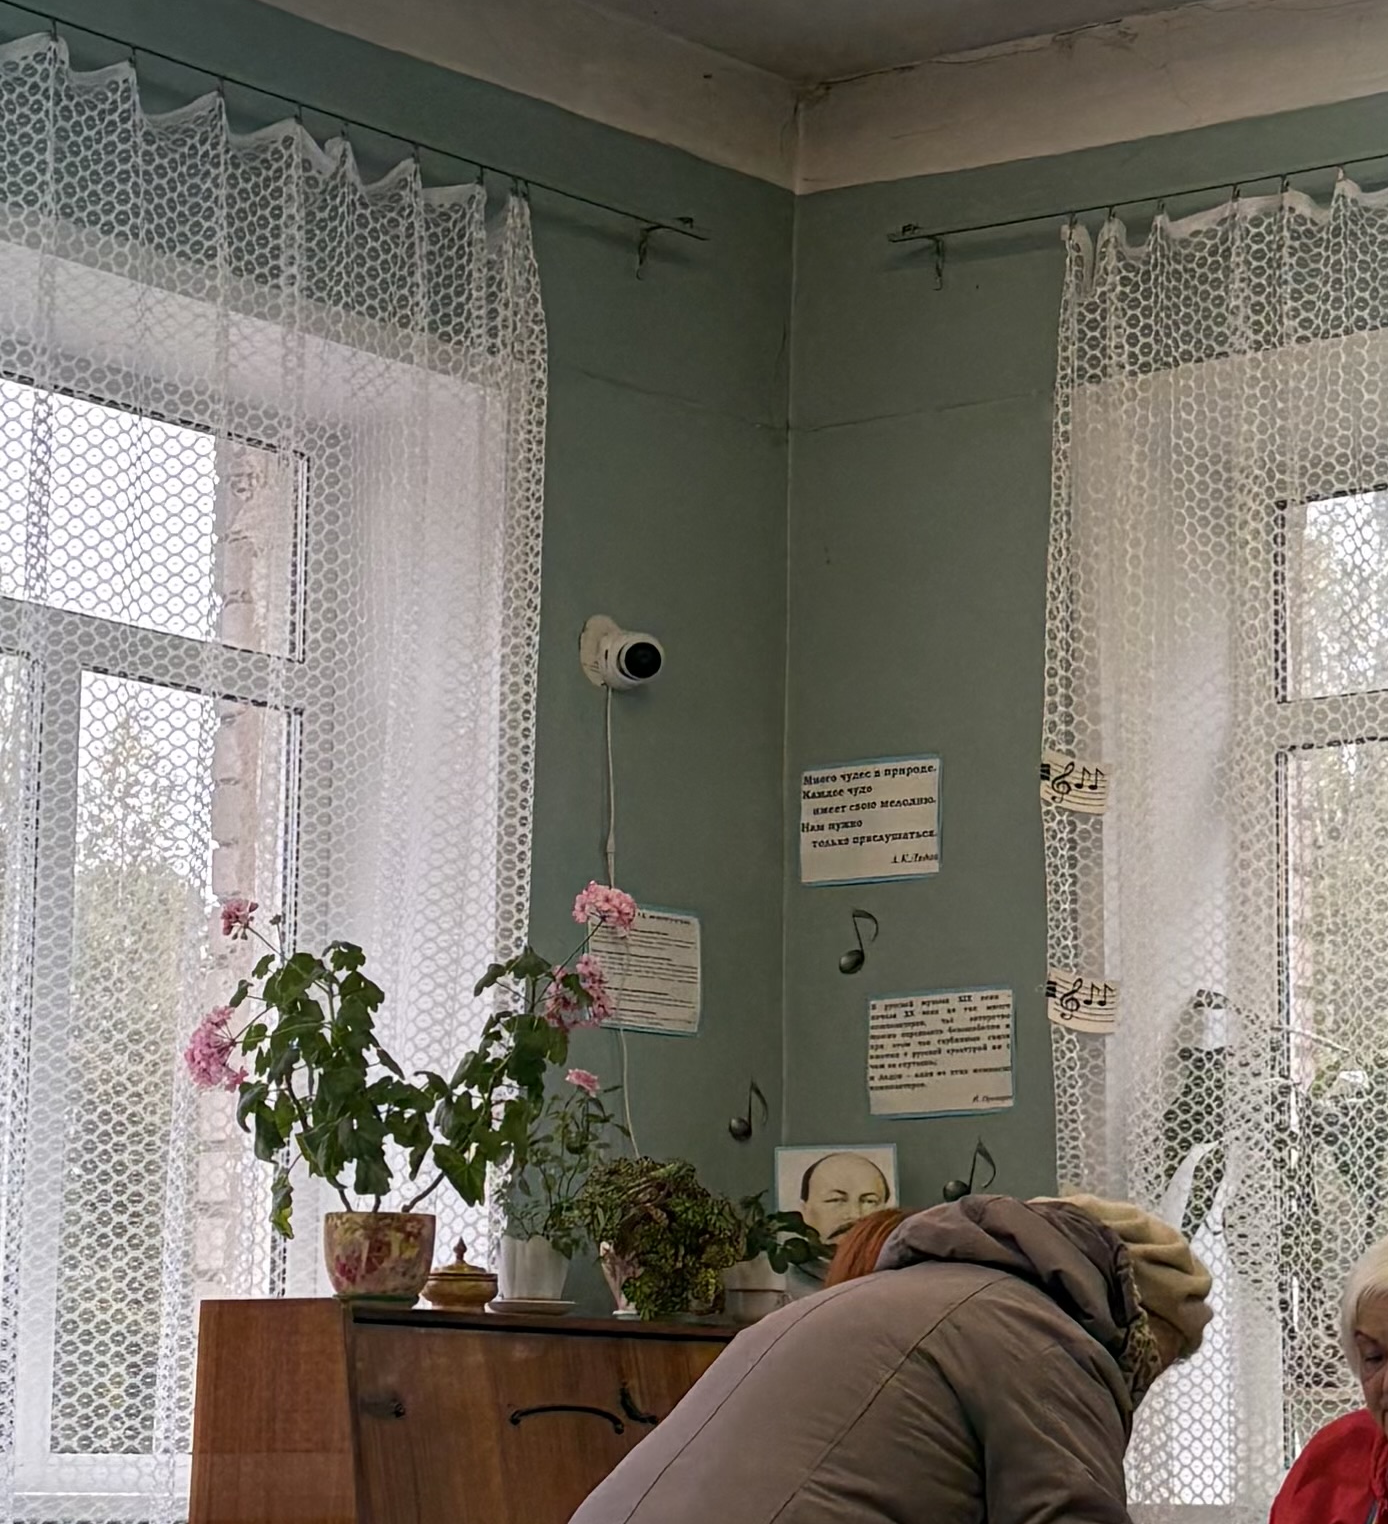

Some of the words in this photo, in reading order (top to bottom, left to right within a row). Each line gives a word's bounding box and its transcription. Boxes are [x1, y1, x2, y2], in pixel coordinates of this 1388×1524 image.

[840, 771, 871, 782] чудес
[884, 765, 936, 778] природе.
[847, 785, 872, 797] чудо
[813, 806, 846, 815] имеет
[849, 802, 877, 811] свою
[880, 796, 936, 808] мелодию.
[802, 822, 825, 832] Нам
[828, 820, 862, 831] нужно
[812, 837, 849, 848] только
[852, 830, 937, 846] прислушаться.
